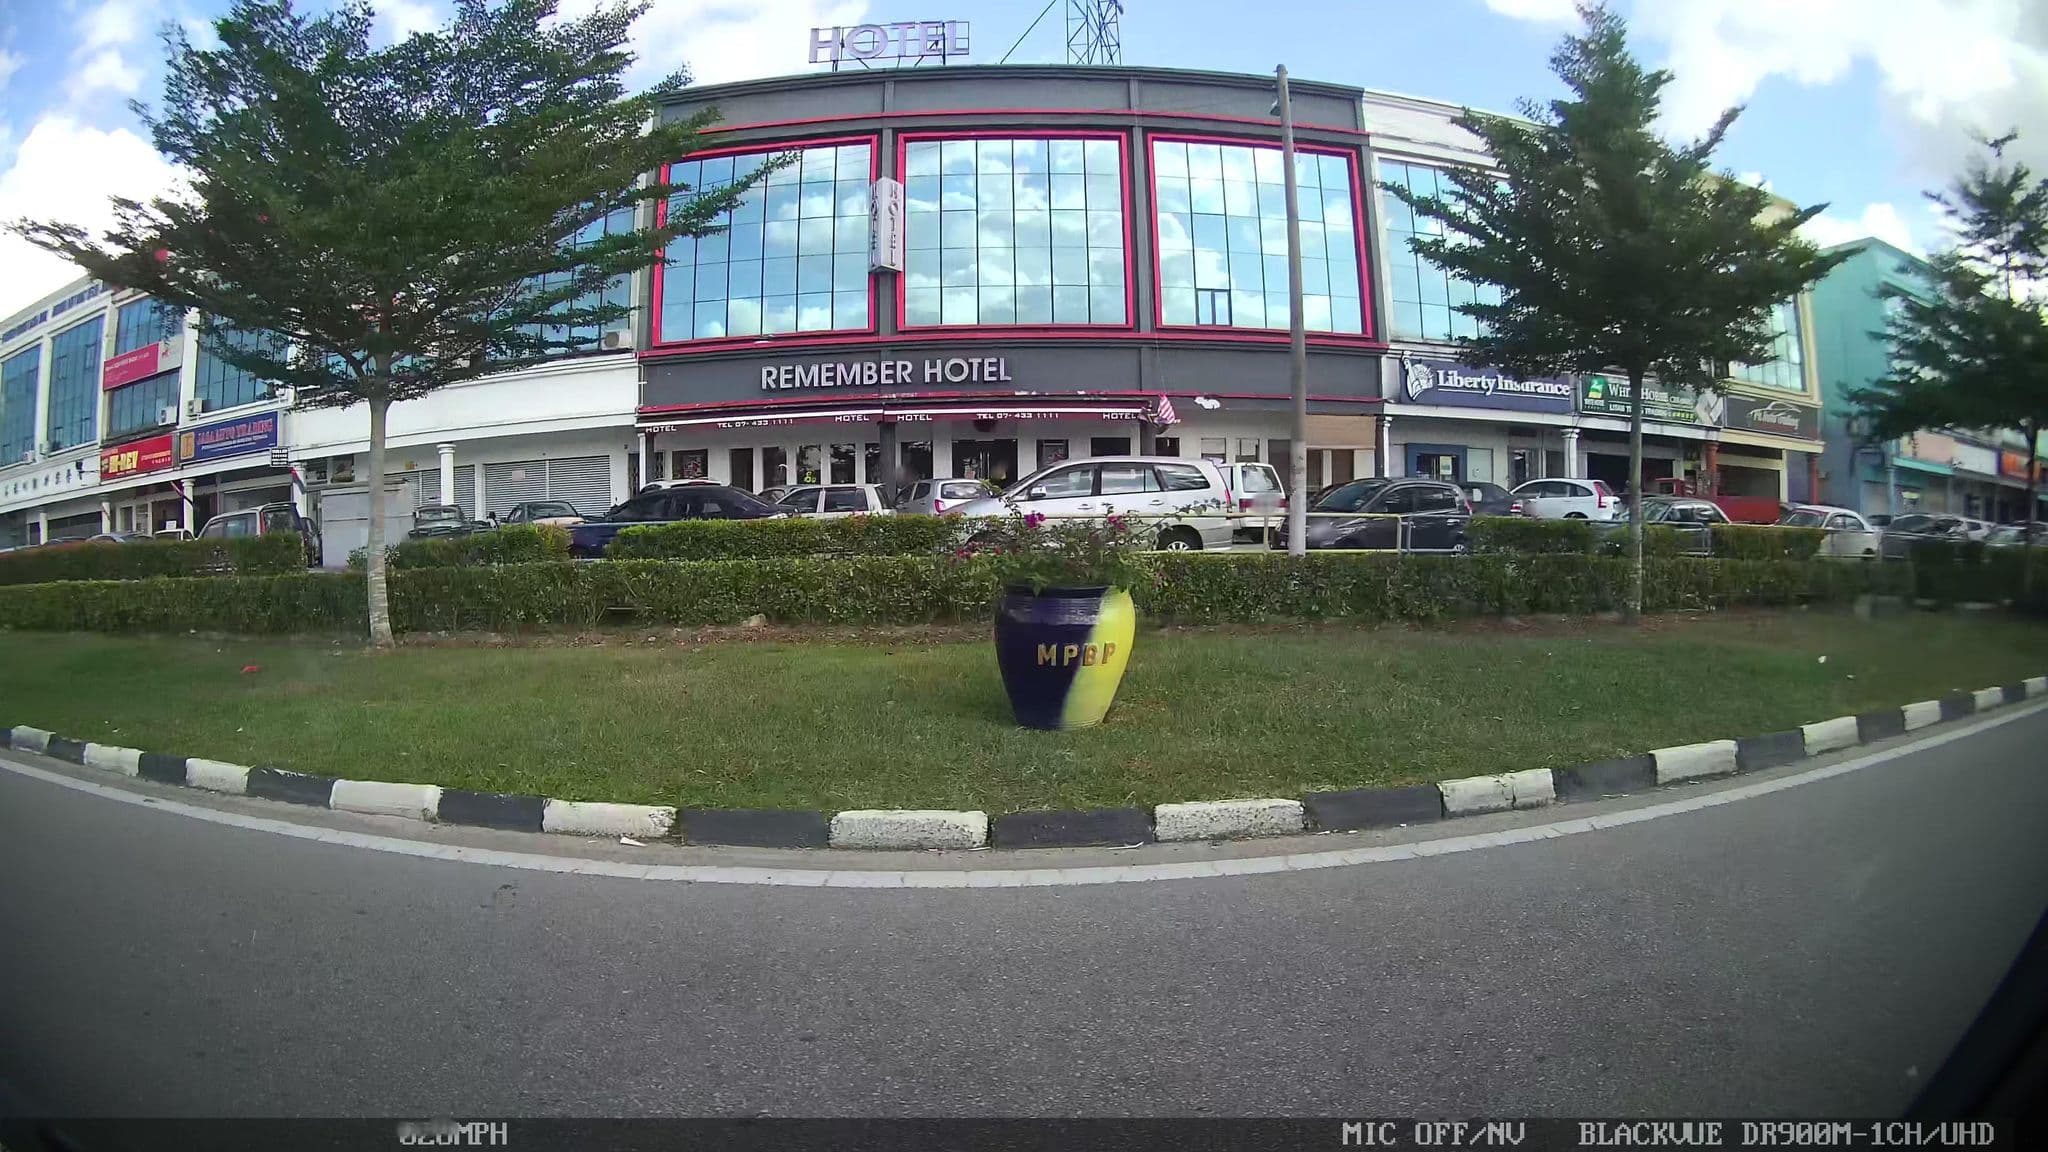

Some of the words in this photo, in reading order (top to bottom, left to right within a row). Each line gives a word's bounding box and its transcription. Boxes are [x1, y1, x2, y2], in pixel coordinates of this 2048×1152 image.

[809, 20, 969, 63] HOTEL
[761, 360, 913, 390] REMEMBER
[924, 357, 1012, 383] HOTEL
[1437, 369, 1496, 396] Liberty
[1497, 374, 1572, 396] Insurance
[645, 425, 677, 433] HOTEL
[834, 414, 870, 422] HOTEL
[897, 413, 933, 421] HOTEL
[1102, 412, 1138, 420] HOTEL
[1036, 641, 1117, 667] MPBP
